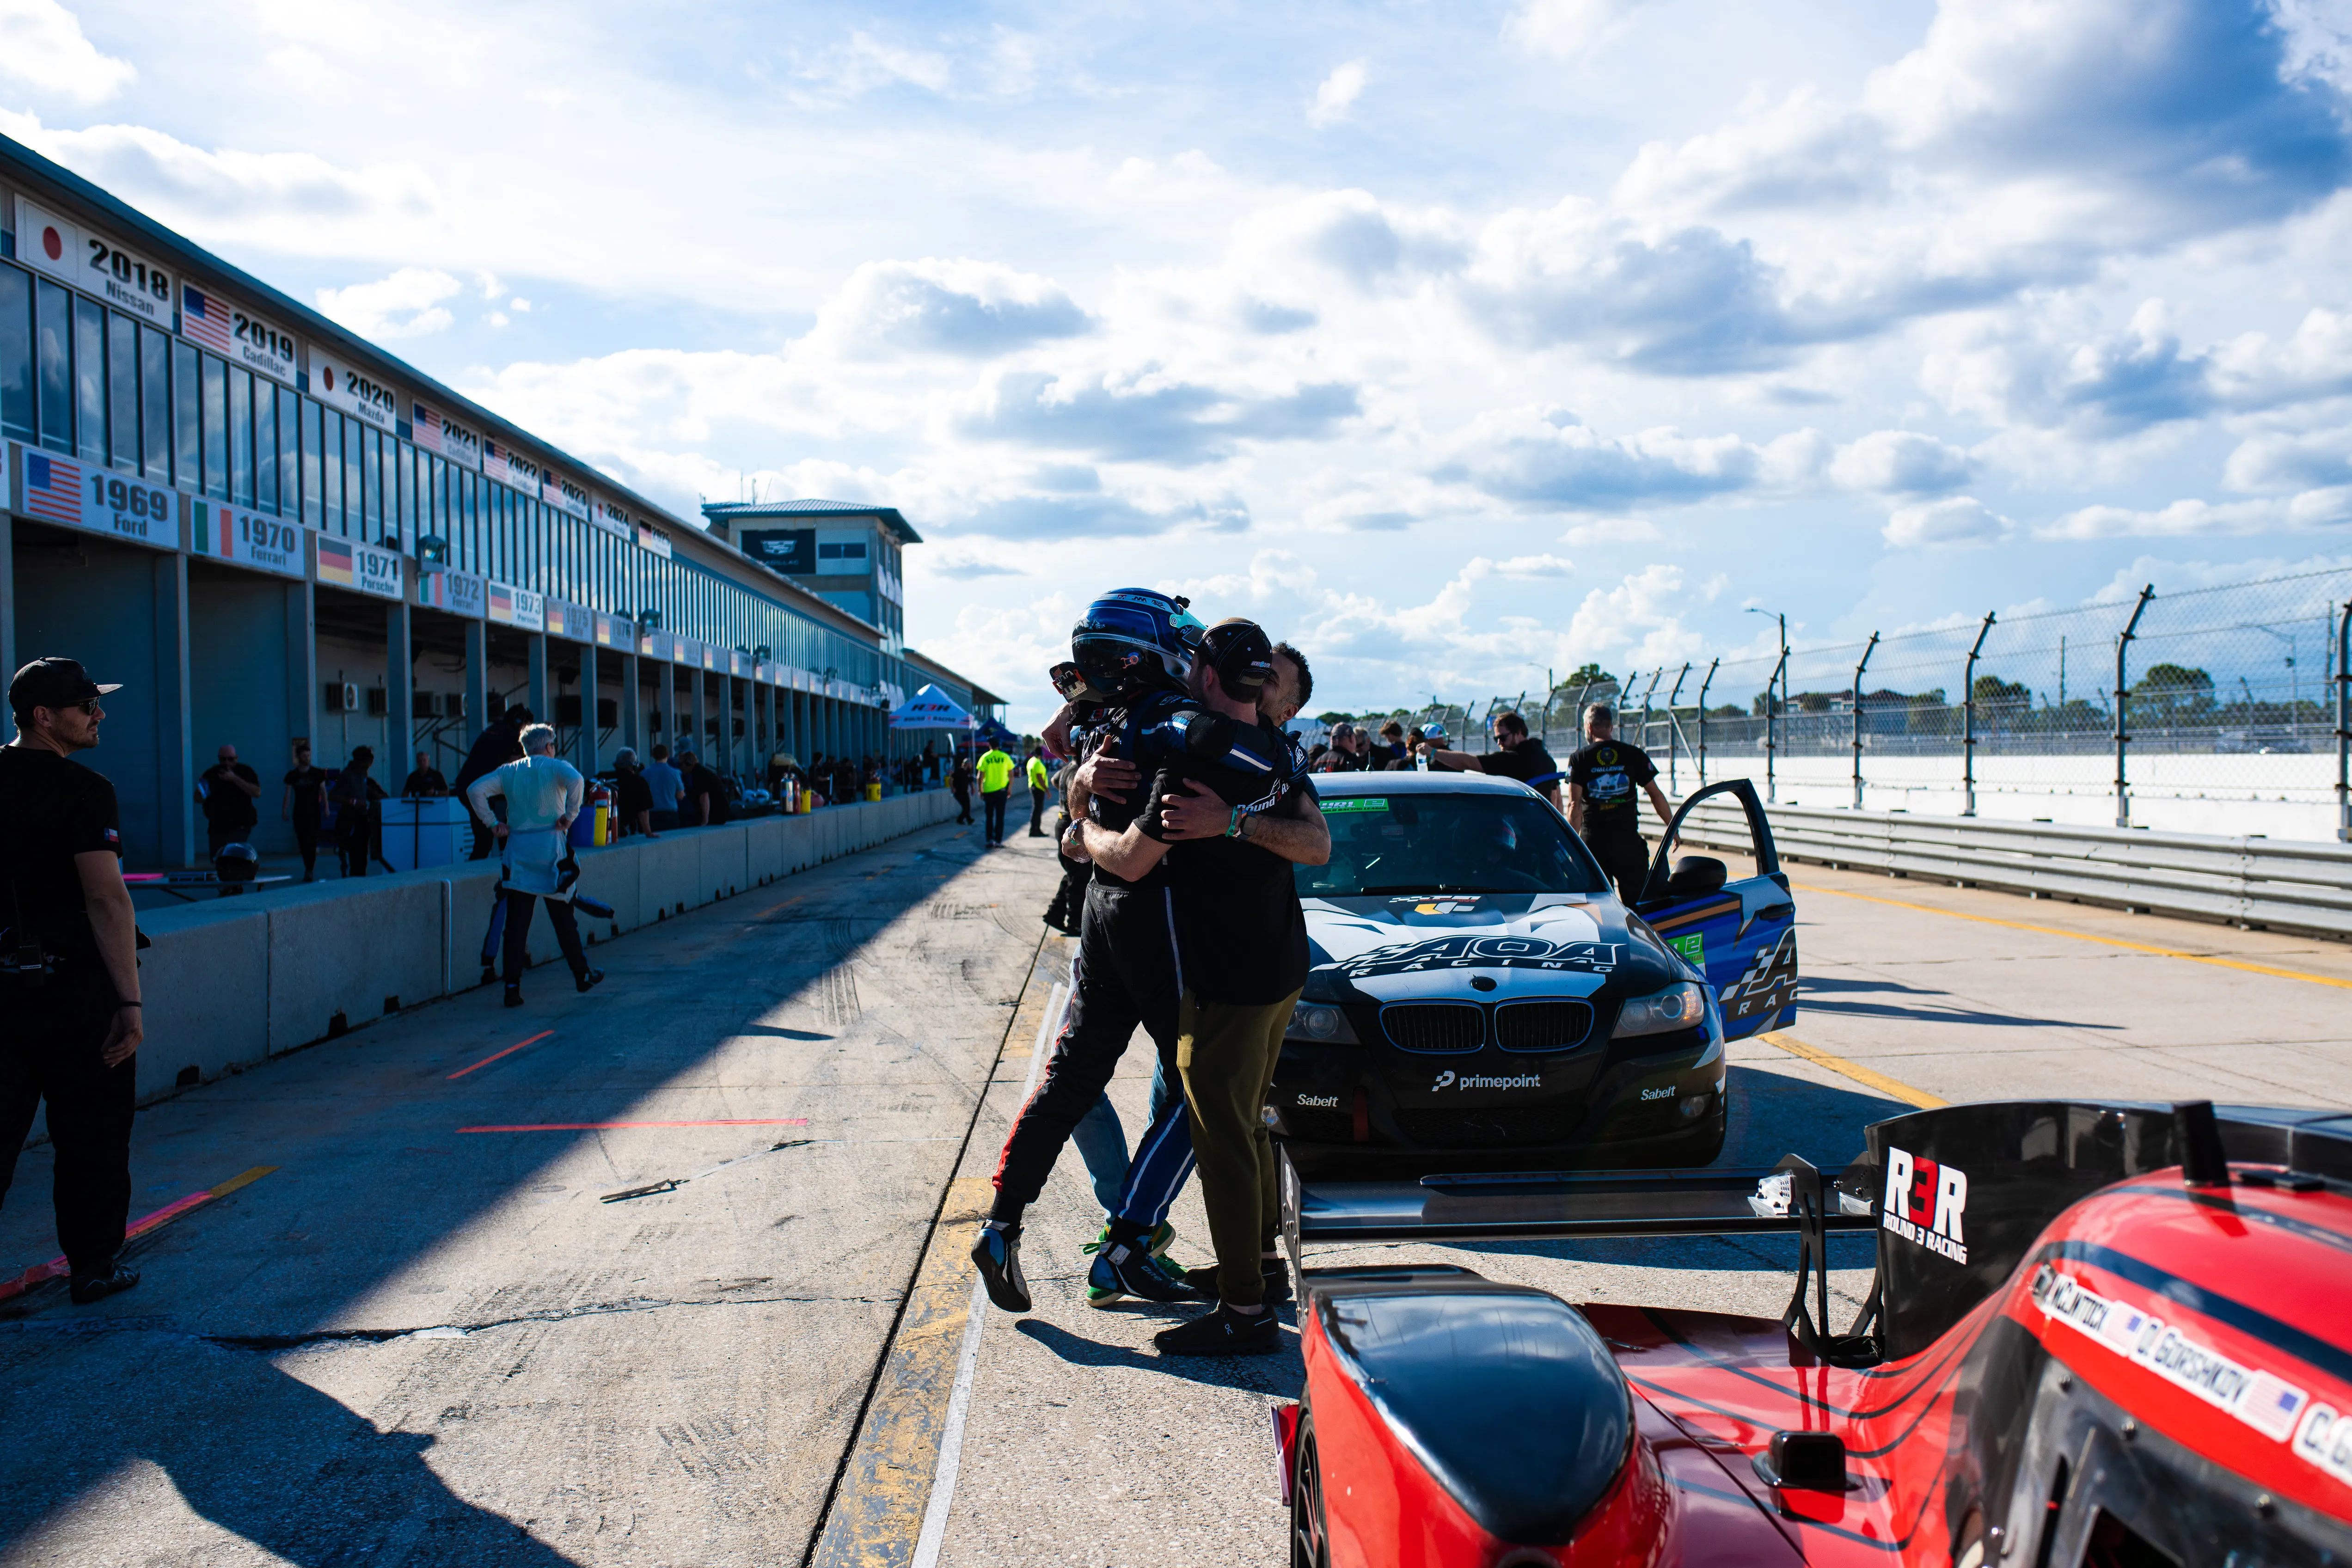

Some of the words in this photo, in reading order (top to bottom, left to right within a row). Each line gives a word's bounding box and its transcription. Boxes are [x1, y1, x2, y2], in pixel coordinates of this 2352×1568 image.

[89, 239, 169, 302] 2018
[106, 279, 154, 317] Nissan
[234, 312, 294, 362] 2019
[243, 346, 287, 378] Cadillac
[346, 370, 395, 413] 2020
[358, 401, 386, 425] Mazda
[442, 419, 478, 453] 2021
[90, 474, 168, 522] 1969
[114, 512, 147, 537] Ford
[239, 514, 295, 553] 1970
[251, 545, 287, 566] Ferrari
[356, 551, 398, 582] 1971
[361, 575, 395, 595] Porsche
[447, 573, 479, 600] 1972
[515, 591, 541, 615] 1973
[1133, 639, 1156, 649] McClintock
[1349, 959, 1616, 977] RACING
[1460, 1073, 1540, 1091] primepoint
[1641, 1084, 1676, 1101] Sabelt
[1297, 1094, 1339, 1108] Sabelt
[1884, 1146, 1967, 1243] R3R
[1882, 1211, 1915, 1241] ROUND
[1916, 1226, 1925, 1245] 3
[1925, 1231, 1967, 1265] RACING
